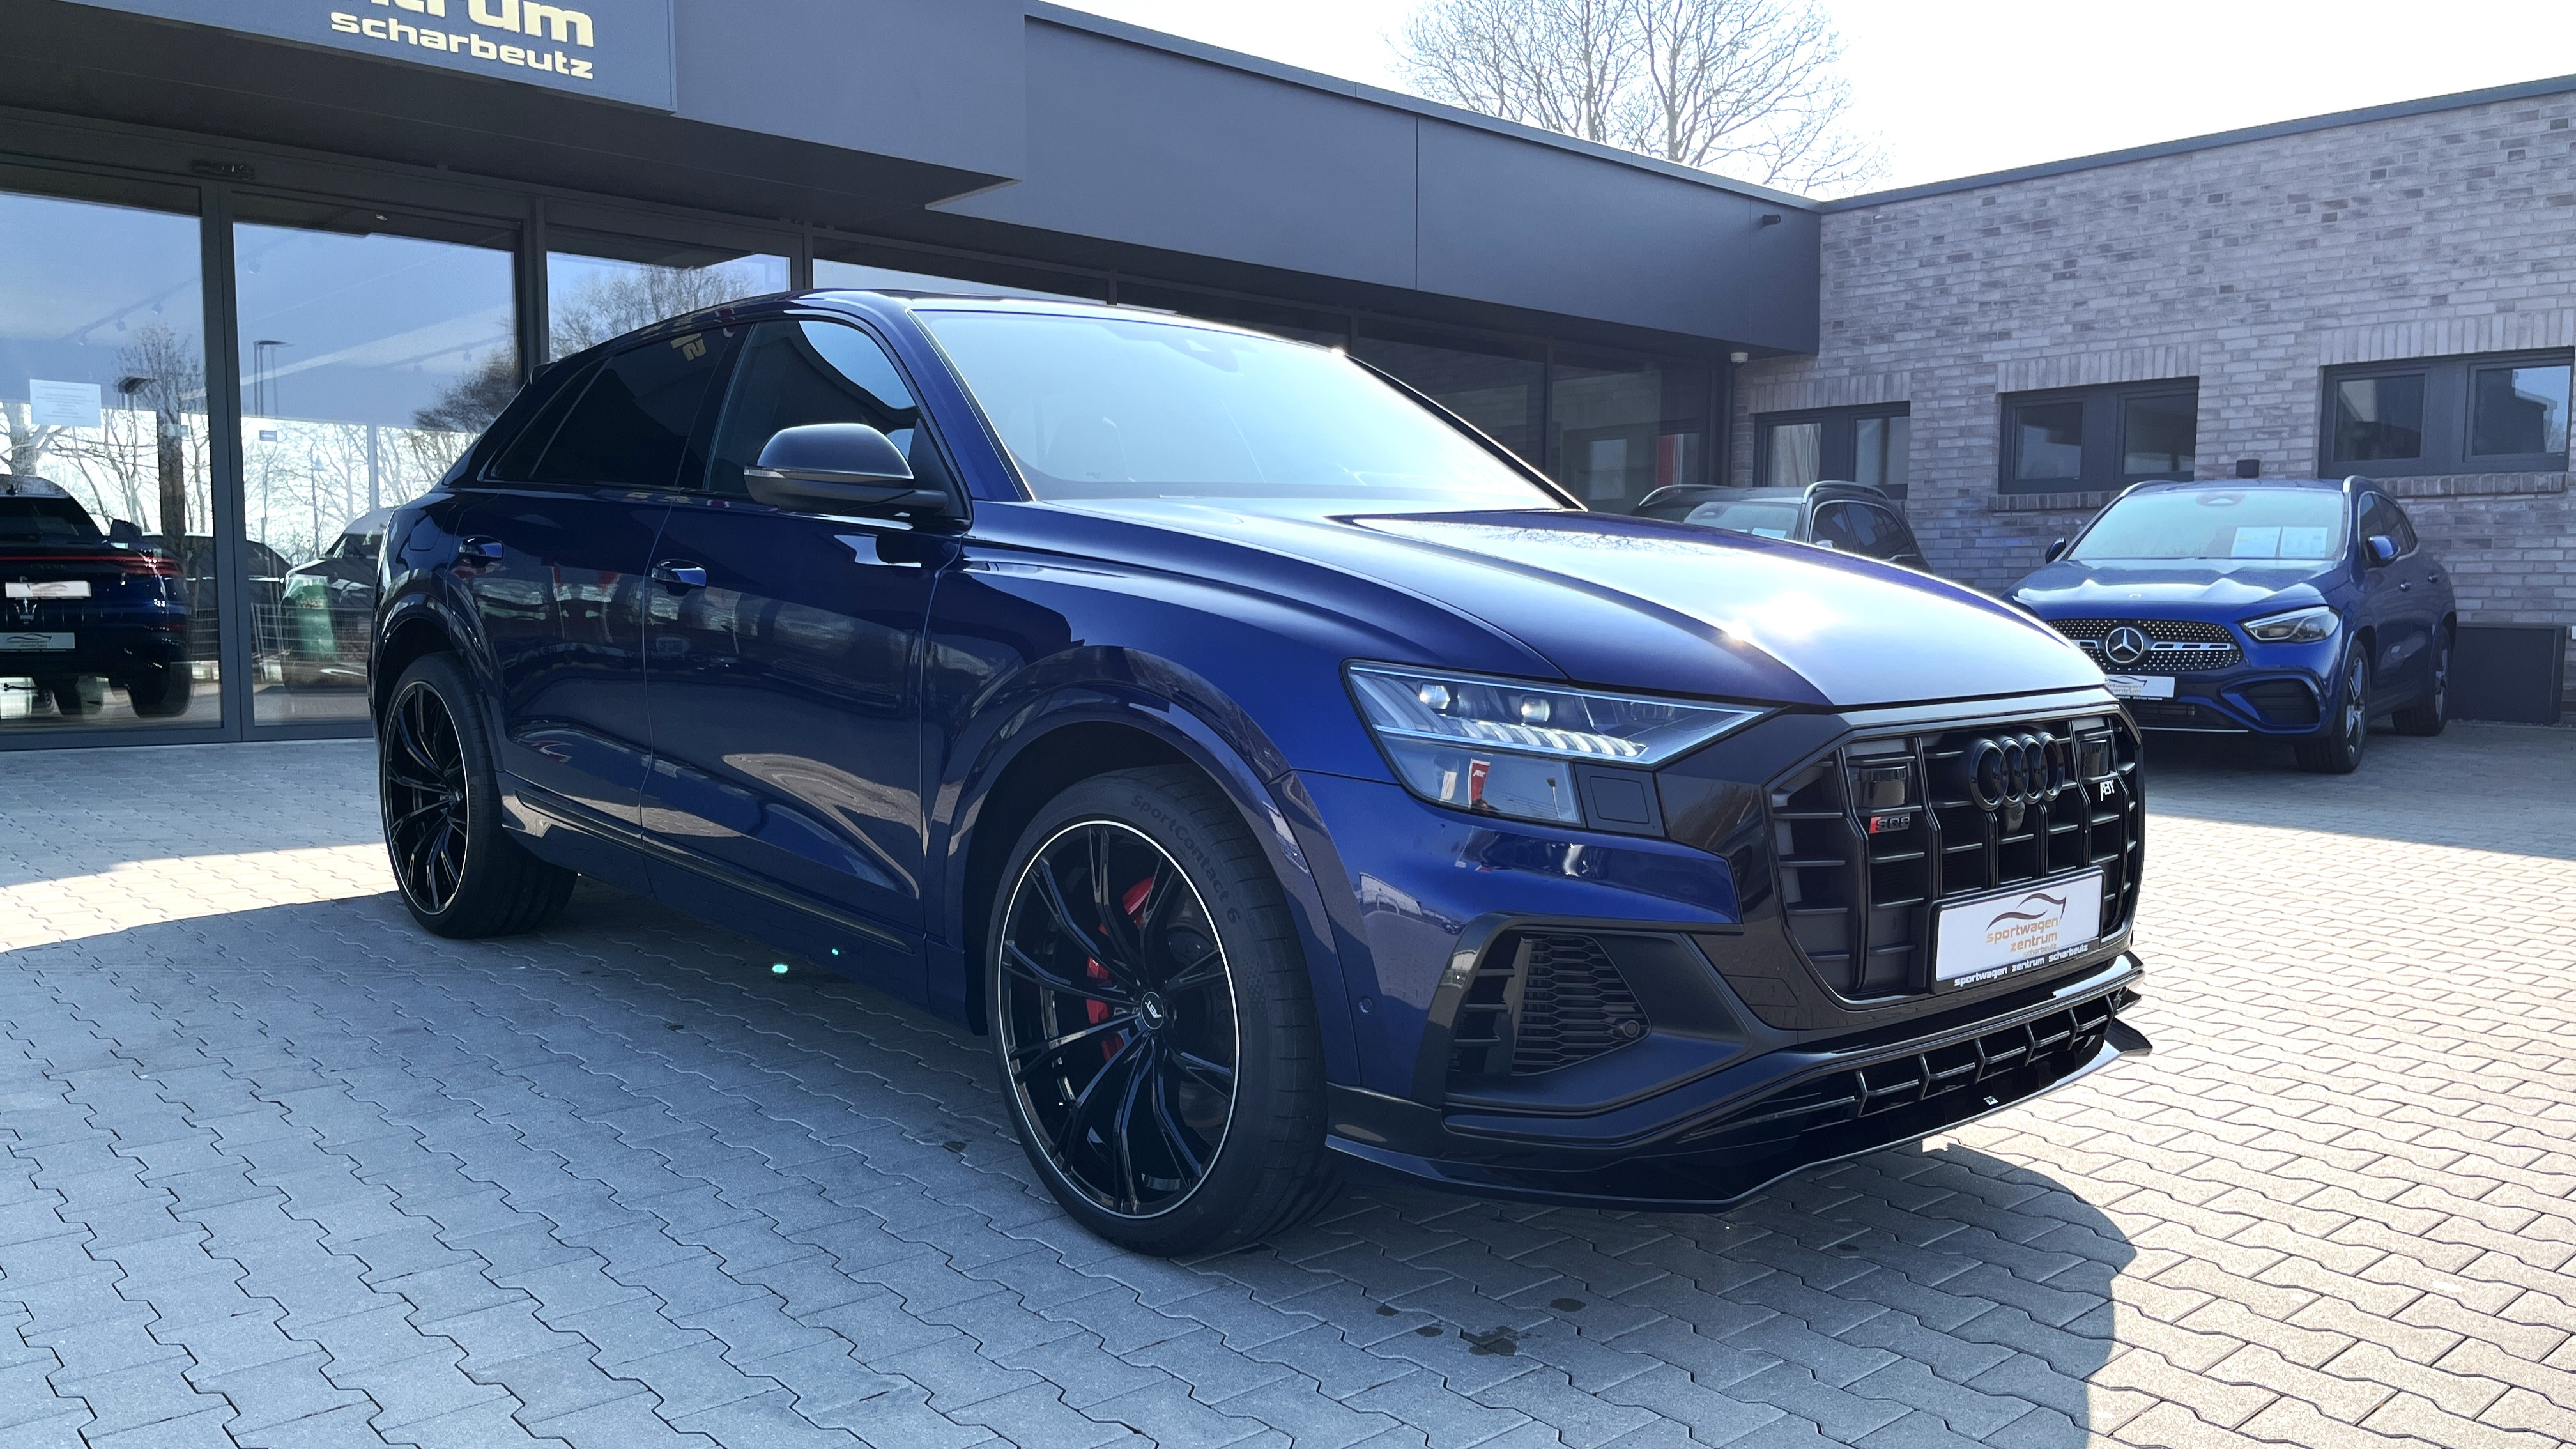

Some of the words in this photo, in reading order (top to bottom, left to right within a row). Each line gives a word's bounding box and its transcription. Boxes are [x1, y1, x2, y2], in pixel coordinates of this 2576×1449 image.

[330, 12, 594, 79] scharbeutz
[2100, 779, 2115, 801] ABT
[1877, 816, 1910, 832] SQ8
[1130, 794, 1229, 903] SportContact
[1227, 907, 1241, 924] 6
[1986, 917, 2058, 944] sportwagen
[2010, 932, 2057, 952] zentrum
[2023, 943, 2057, 956] scharbeutz
[1954, 967, 2007, 987] sportwagen
[2012, 957, 2044, 972] zentrum
[2048, 944, 2088, 962] scharbeutz
